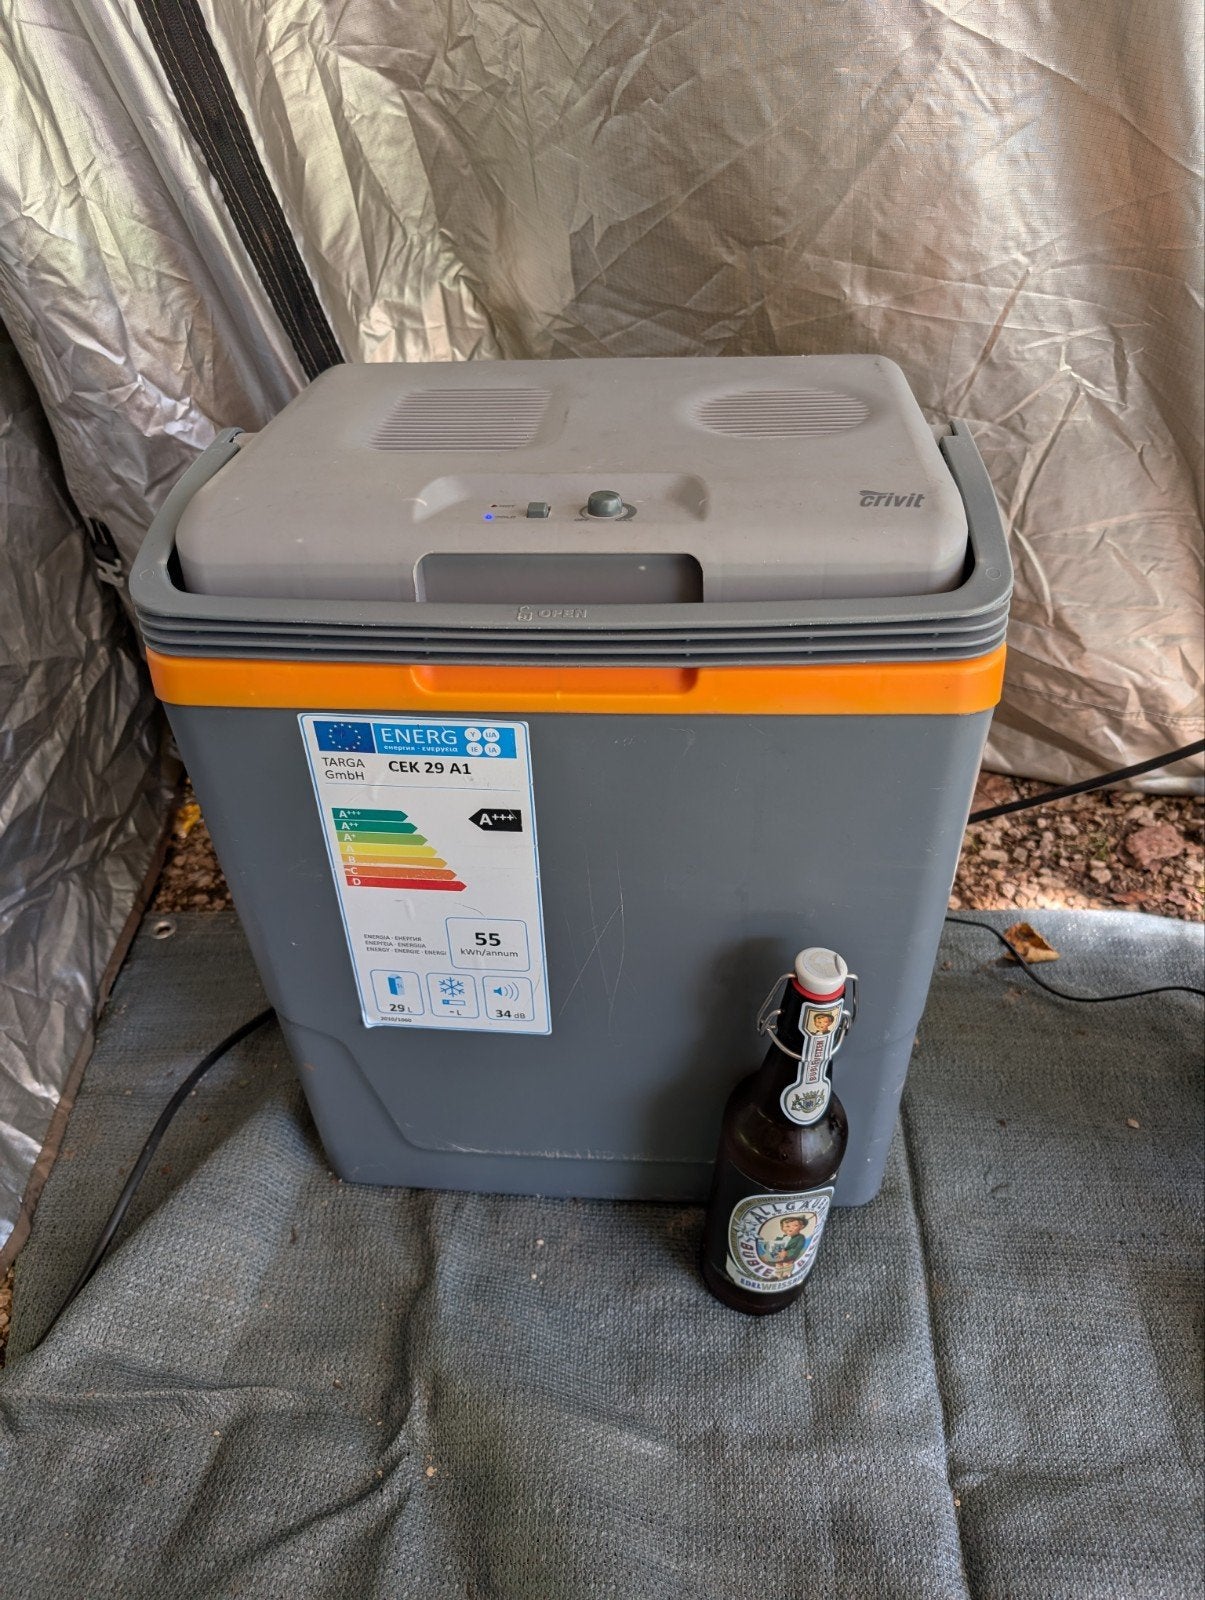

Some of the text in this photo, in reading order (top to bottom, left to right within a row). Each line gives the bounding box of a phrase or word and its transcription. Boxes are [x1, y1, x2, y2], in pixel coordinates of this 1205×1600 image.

[859, 490, 925, 508] crivit
[381, 727, 457, 746] ENERG
[321, 757, 365, 768] TARGA
[388, 760, 472, 775] CEK 29 A1
[325, 769, 365, 781] GmbH
[339, 810, 361, 819] A+++
[479, 813, 515, 826] A+++
[341, 822, 358, 830] A++
[343, 833, 356, 842] A+
[346, 845, 354, 853] A
[350, 867, 358, 875] C
[475, 932, 501, 947] 55
[460, 948, 519, 958] kWh/annum
[389, 1003, 405, 1012] 29
[495, 1009, 511, 1018] 34
